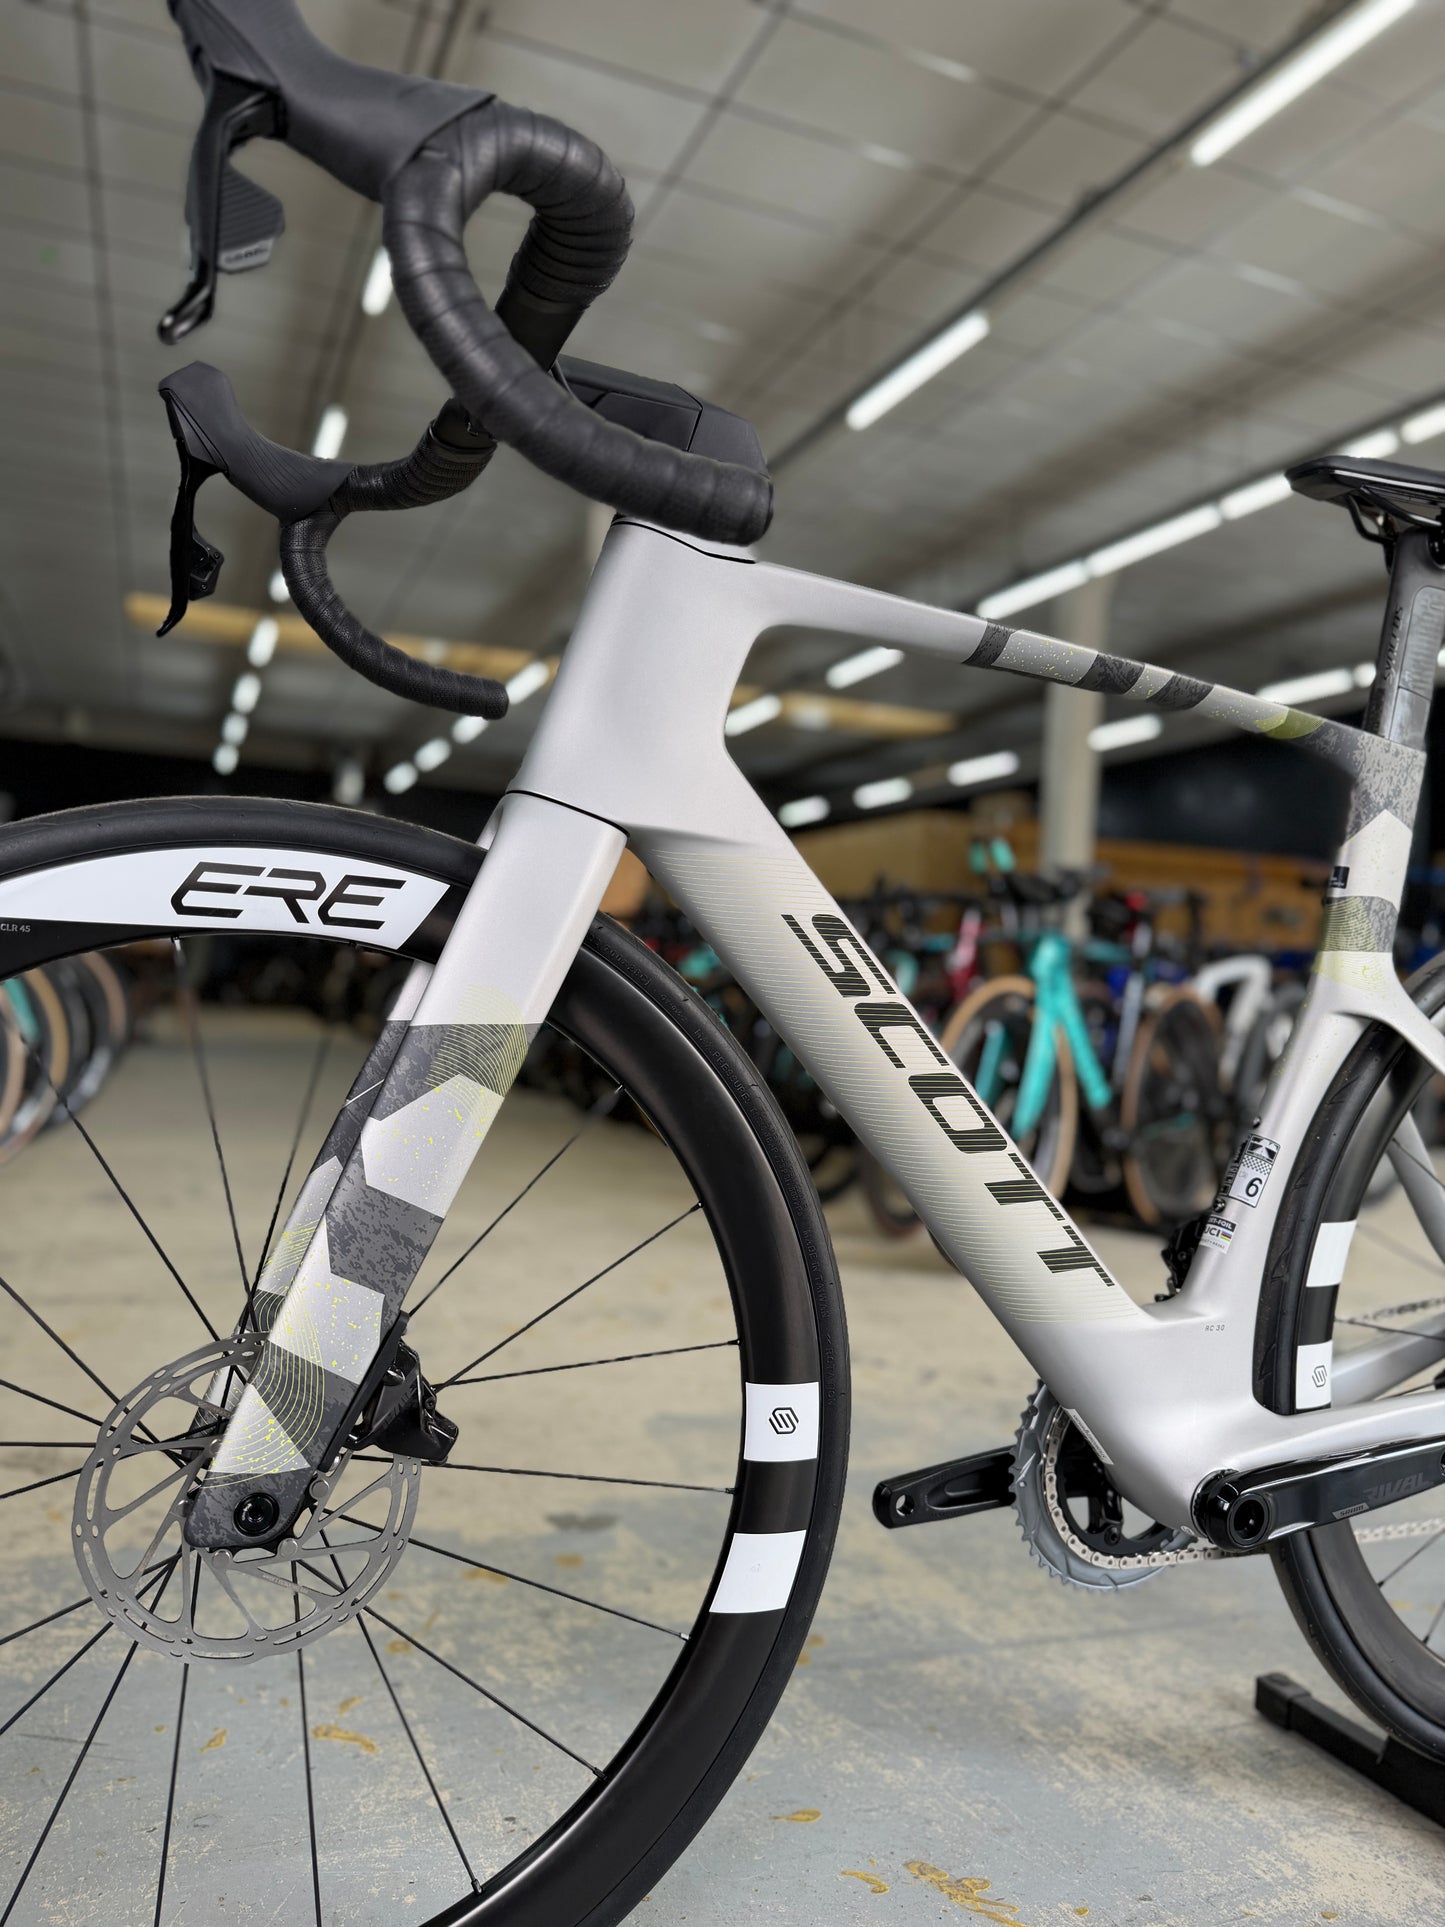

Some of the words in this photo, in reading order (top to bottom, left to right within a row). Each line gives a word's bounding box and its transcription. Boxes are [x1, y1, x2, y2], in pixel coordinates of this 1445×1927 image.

[171, 861, 407, 930] ERE
[0, 923, 18, 932] CLR
[19, 924, 31, 933] 45
[780, 913, 1116, 1287] SCOTT
[1245, 1177, 1263, 1198] 6
[1361, 1472, 1434, 1501] RIVAL
